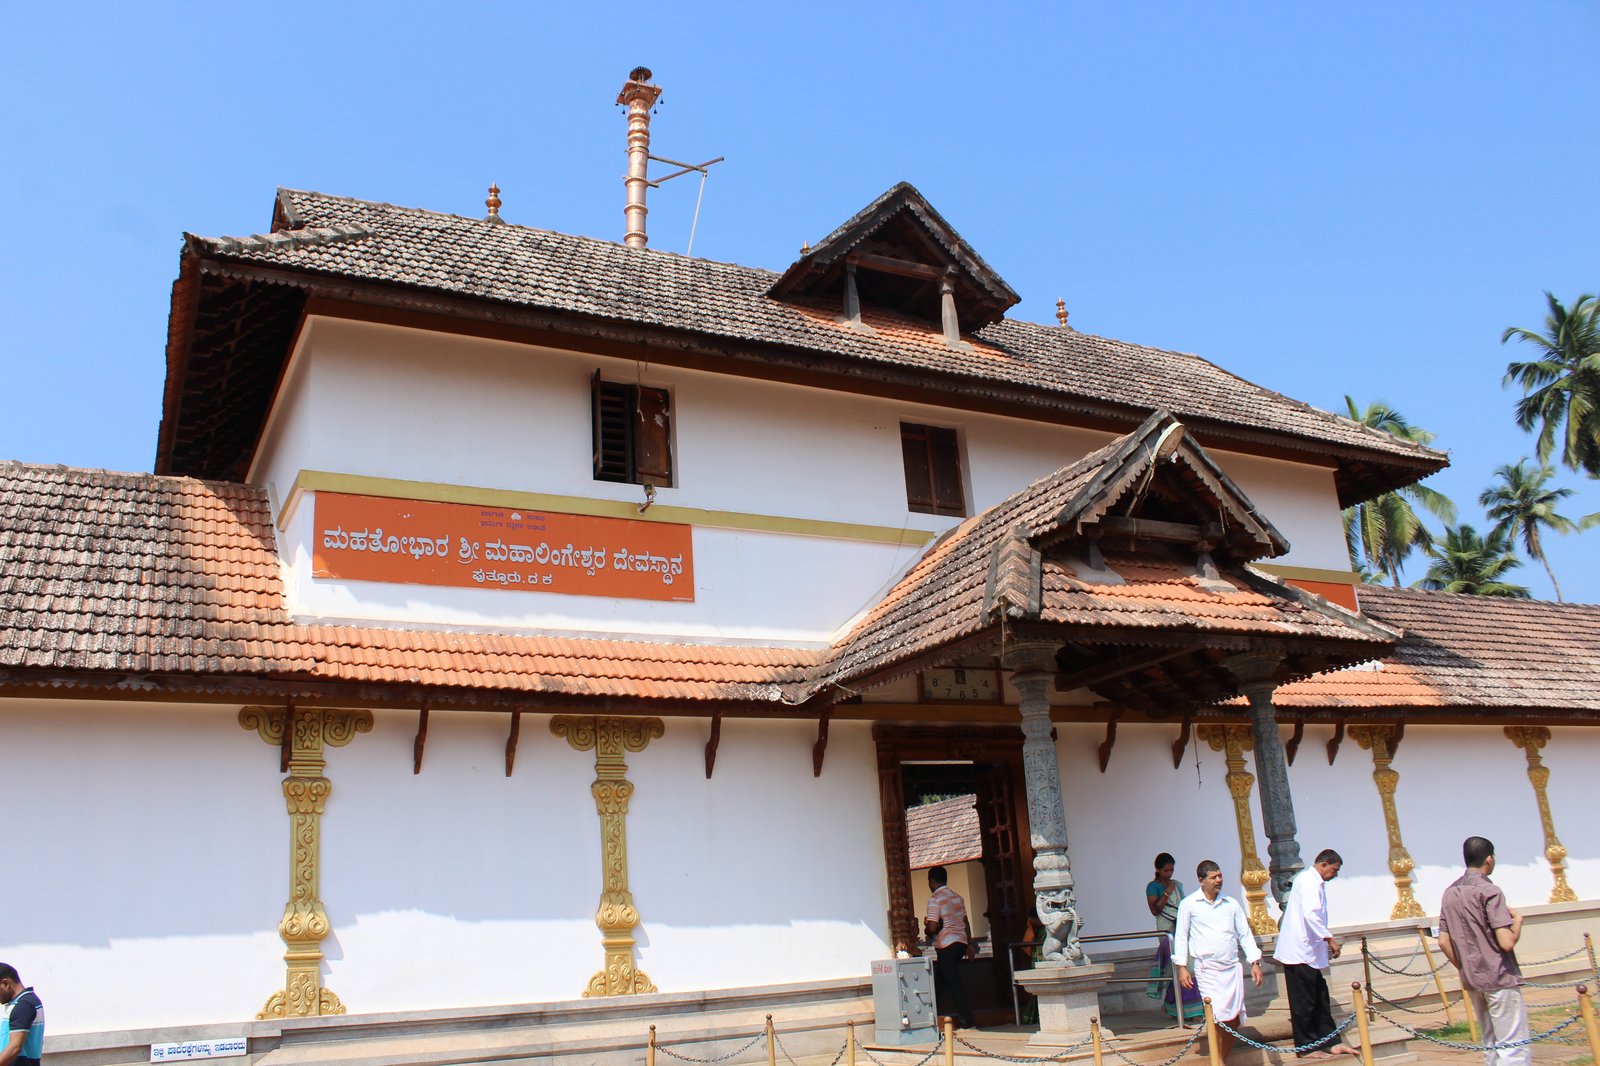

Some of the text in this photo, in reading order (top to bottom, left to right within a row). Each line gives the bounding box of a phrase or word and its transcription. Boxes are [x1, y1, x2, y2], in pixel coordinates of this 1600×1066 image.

[323, 525, 683, 585] ಮಹತೋಭಾರ ಶ್ರೀ ಮಹಾಲಿಂಗೇಶ್ವರ ದೇವಸ್ಥಾನ
[932, 678, 938, 687] 8
[945, 688, 951, 697] 7
[972, 688, 978, 697] 5
[983, 679, 989, 688] 4
